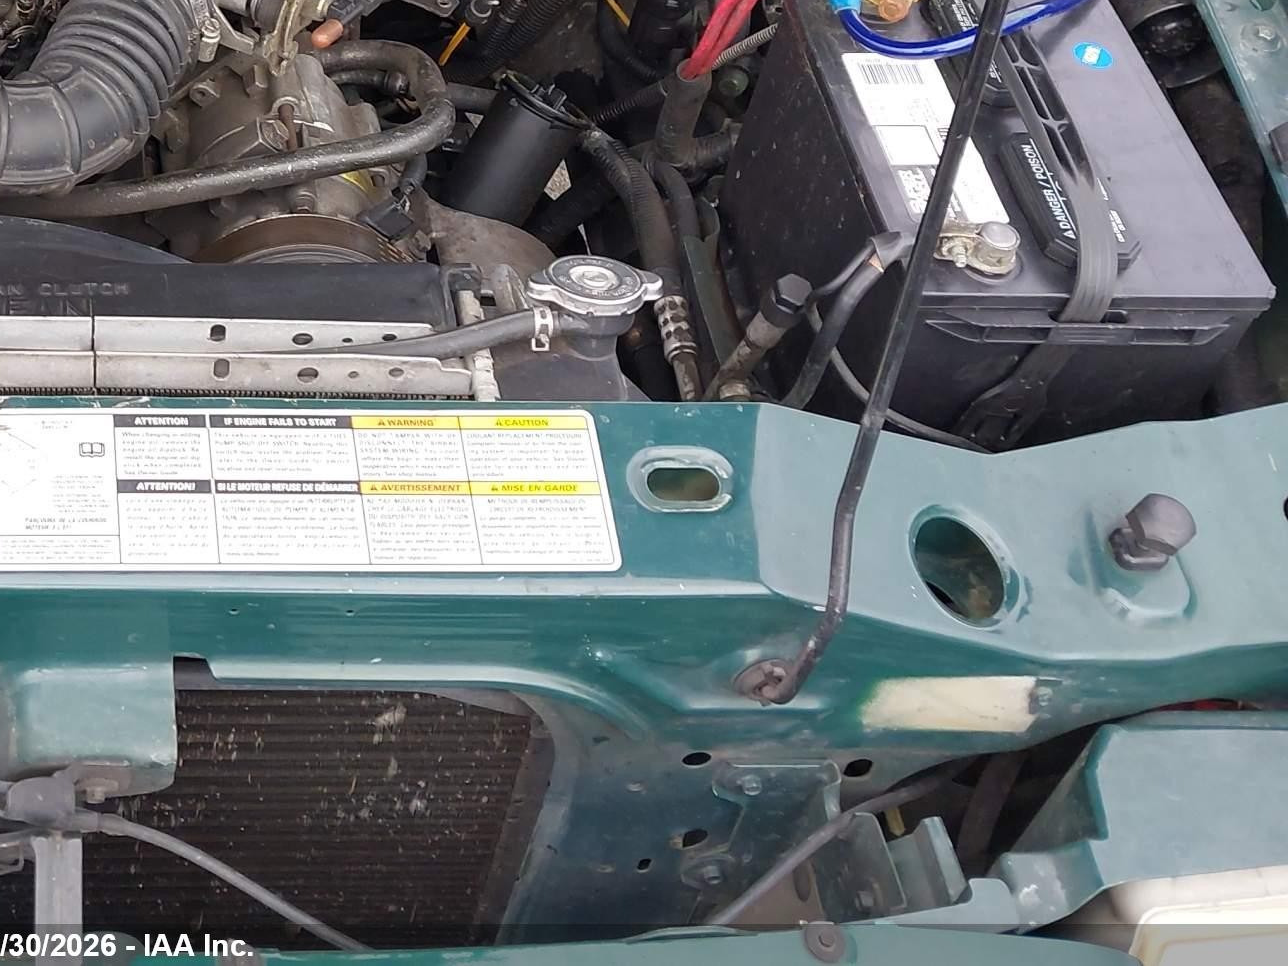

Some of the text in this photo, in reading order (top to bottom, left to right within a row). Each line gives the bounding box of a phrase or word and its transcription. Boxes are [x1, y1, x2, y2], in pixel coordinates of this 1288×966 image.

[1021, 144, 1048, 180] POISON
[1042, 188, 1072, 229] DANGER
[38, 282, 131, 297] CLUTCH
[134, 416, 189, 426] ATTENTION
[223, 417, 337, 427] IF ENGINE FAILS TO START
[386, 419, 434, 427] WARNING
[503, 419, 549, 427] CAUTION
[135, 481, 196, 491] ATTENTION!
[226, 482, 237, 492] LE
[237, 482, 271, 492] MOTEUR
[272, 483, 302, 492] REFUSE
[303, 483, 314, 493] DE
[380, 484, 461, 492] AVERTISSEMENT
[501, 484, 578, 492] MISE EN GARDE
